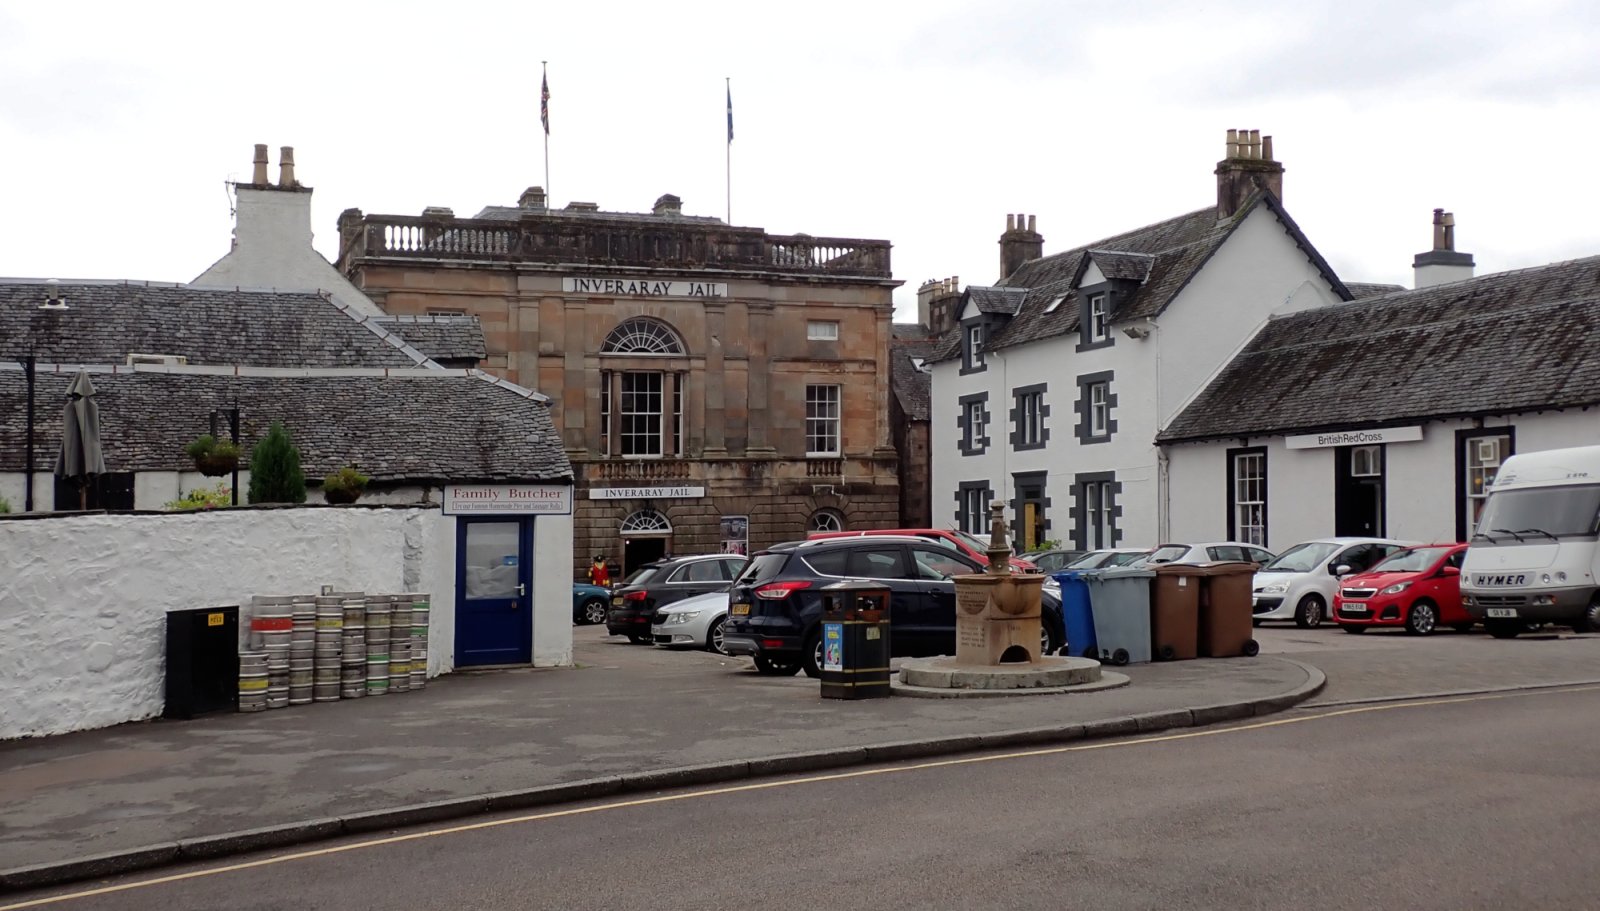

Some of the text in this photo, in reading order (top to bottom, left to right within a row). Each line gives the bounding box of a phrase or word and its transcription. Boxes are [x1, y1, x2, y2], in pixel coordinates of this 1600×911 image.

[573, 278, 722, 297] INVERARAY JAIL
[1318, 433, 1383, 445] BritishRedCross
[453, 488, 564, 501] Family Butcher
[605, 488, 690, 497] INVERARAY JAIL
[1477, 575, 1525, 585] HYMER
